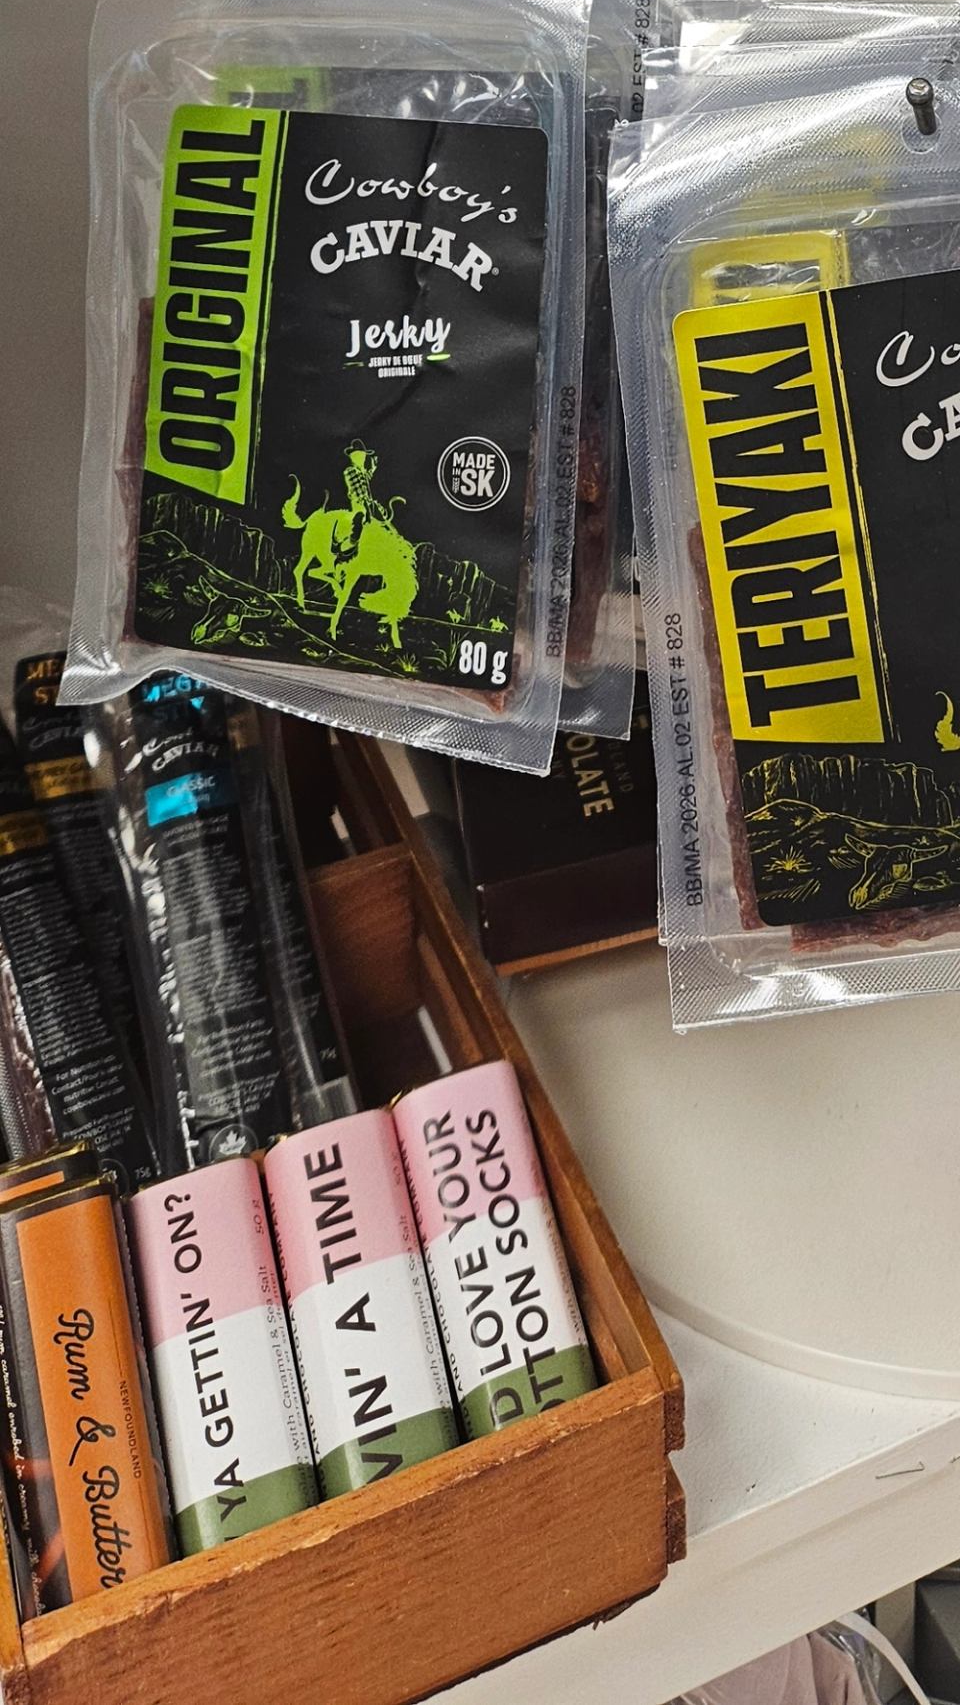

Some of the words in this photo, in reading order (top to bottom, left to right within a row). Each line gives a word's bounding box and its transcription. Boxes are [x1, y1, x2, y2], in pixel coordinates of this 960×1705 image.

[304, 158, 518, 224] Cowboy's
[310, 219, 493, 293] CAVIAR
[158, 117, 267, 473] ORIGINAL
[346, 314, 451, 358] Jerky
[368, 356, 392, 368] JERKY
[561, 386, 578, 422] 828
[452, 451, 496, 470] MADE
[452, 468, 461, 476] IN
[461, 468, 494, 497] SK
[556, 444, 576, 480] EST
[694, 321, 862, 731] TERIYAKI
[458, 639, 487, 676] 80
[490, 650, 508, 685] g
[664, 611, 683, 651] 828
[668, 654, 685, 670] #
[670, 675, 691, 716] EST
[684, 837, 704, 907] BB/MA
[423, 1110, 477, 1244] YOUR
[465, 1108, 529, 1257] SOCKS
[163, 1192, 202, 1275] ON?
[254, 1216, 264, 1233] 50
[303, 1142, 363, 1286] TIME
[258, 1266, 270, 1292] Salt
[265, 1299, 276, 1323] Sea
[270, 1329, 278, 1339] &
[335, 1291, 377, 1333] A
[416, 1290, 434, 1354] Caramel
[454, 1246, 512, 1377] LOVE
[505, 1265, 564, 1408] TTON
[53, 1308, 95, 1401] Rum
[180, 1292, 235, 1449] GETTIN'
[273, 1344, 293, 1408] Caramel
[8, 1409, 21, 1462] enrobed
[15, 1463, 25, 1479] in
[68, 1415, 117, 1467] &
[118, 1379, 142, 1480] NEWFOUNDLAND
[286, 1415, 301, 1451] with
[214, 1457, 247, 1523] YA
[82, 1464, 132, 1589] Butter
